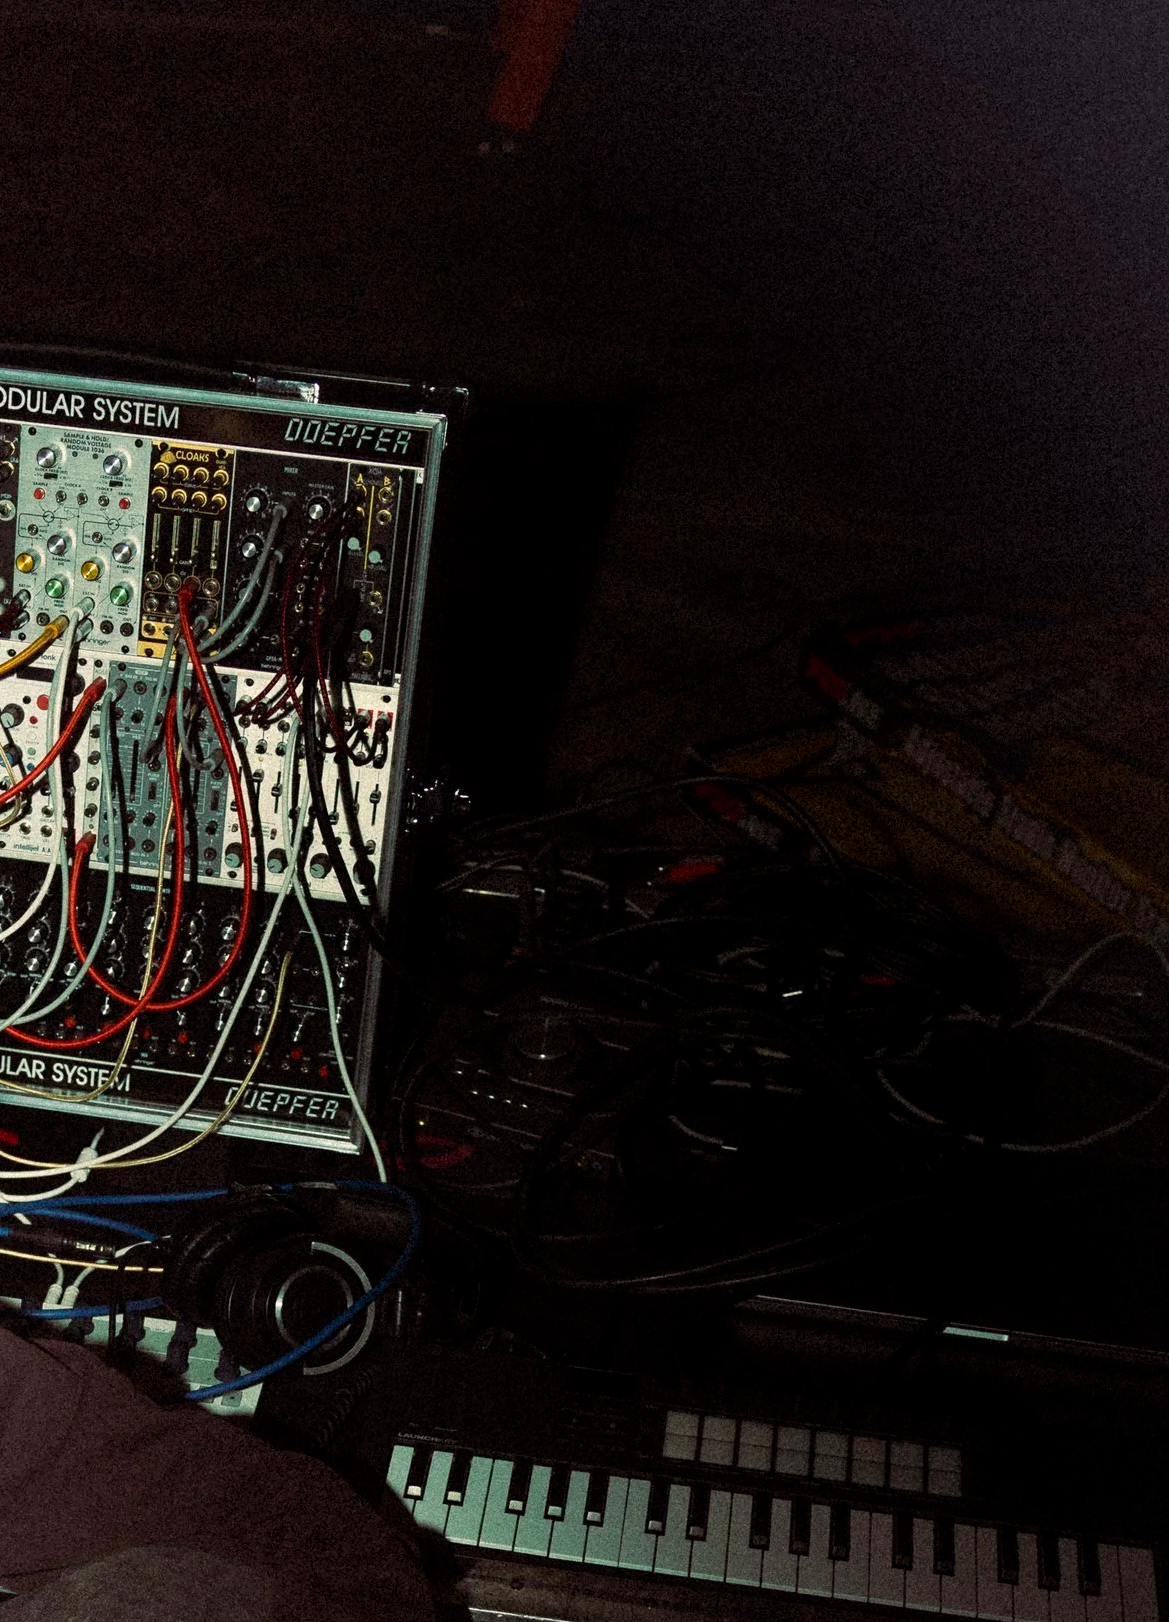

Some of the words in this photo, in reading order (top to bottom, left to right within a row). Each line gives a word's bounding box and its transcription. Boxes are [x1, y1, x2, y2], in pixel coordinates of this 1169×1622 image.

[93, 400, 179, 429] SYSTEM
[63, 432, 85, 440] SAMPLE
[285, 418, 412, 454] DOEPFER
[60, 438, 86, 446] RANDOM
[87, 440, 111, 448] VOLTAGE
[66, 444, 90, 452] MODULE
[175, 450, 210, 463] CLOAKS
[357, 473, 364, 482] A
[383, 475, 391, 485] B
[86, 637, 110, 646] ringer
[13, 843, 39, 852] intellijel
[130, 883, 156, 893] SEQUENTIAL
[51, 1063, 131, 1092] SYSTEM
